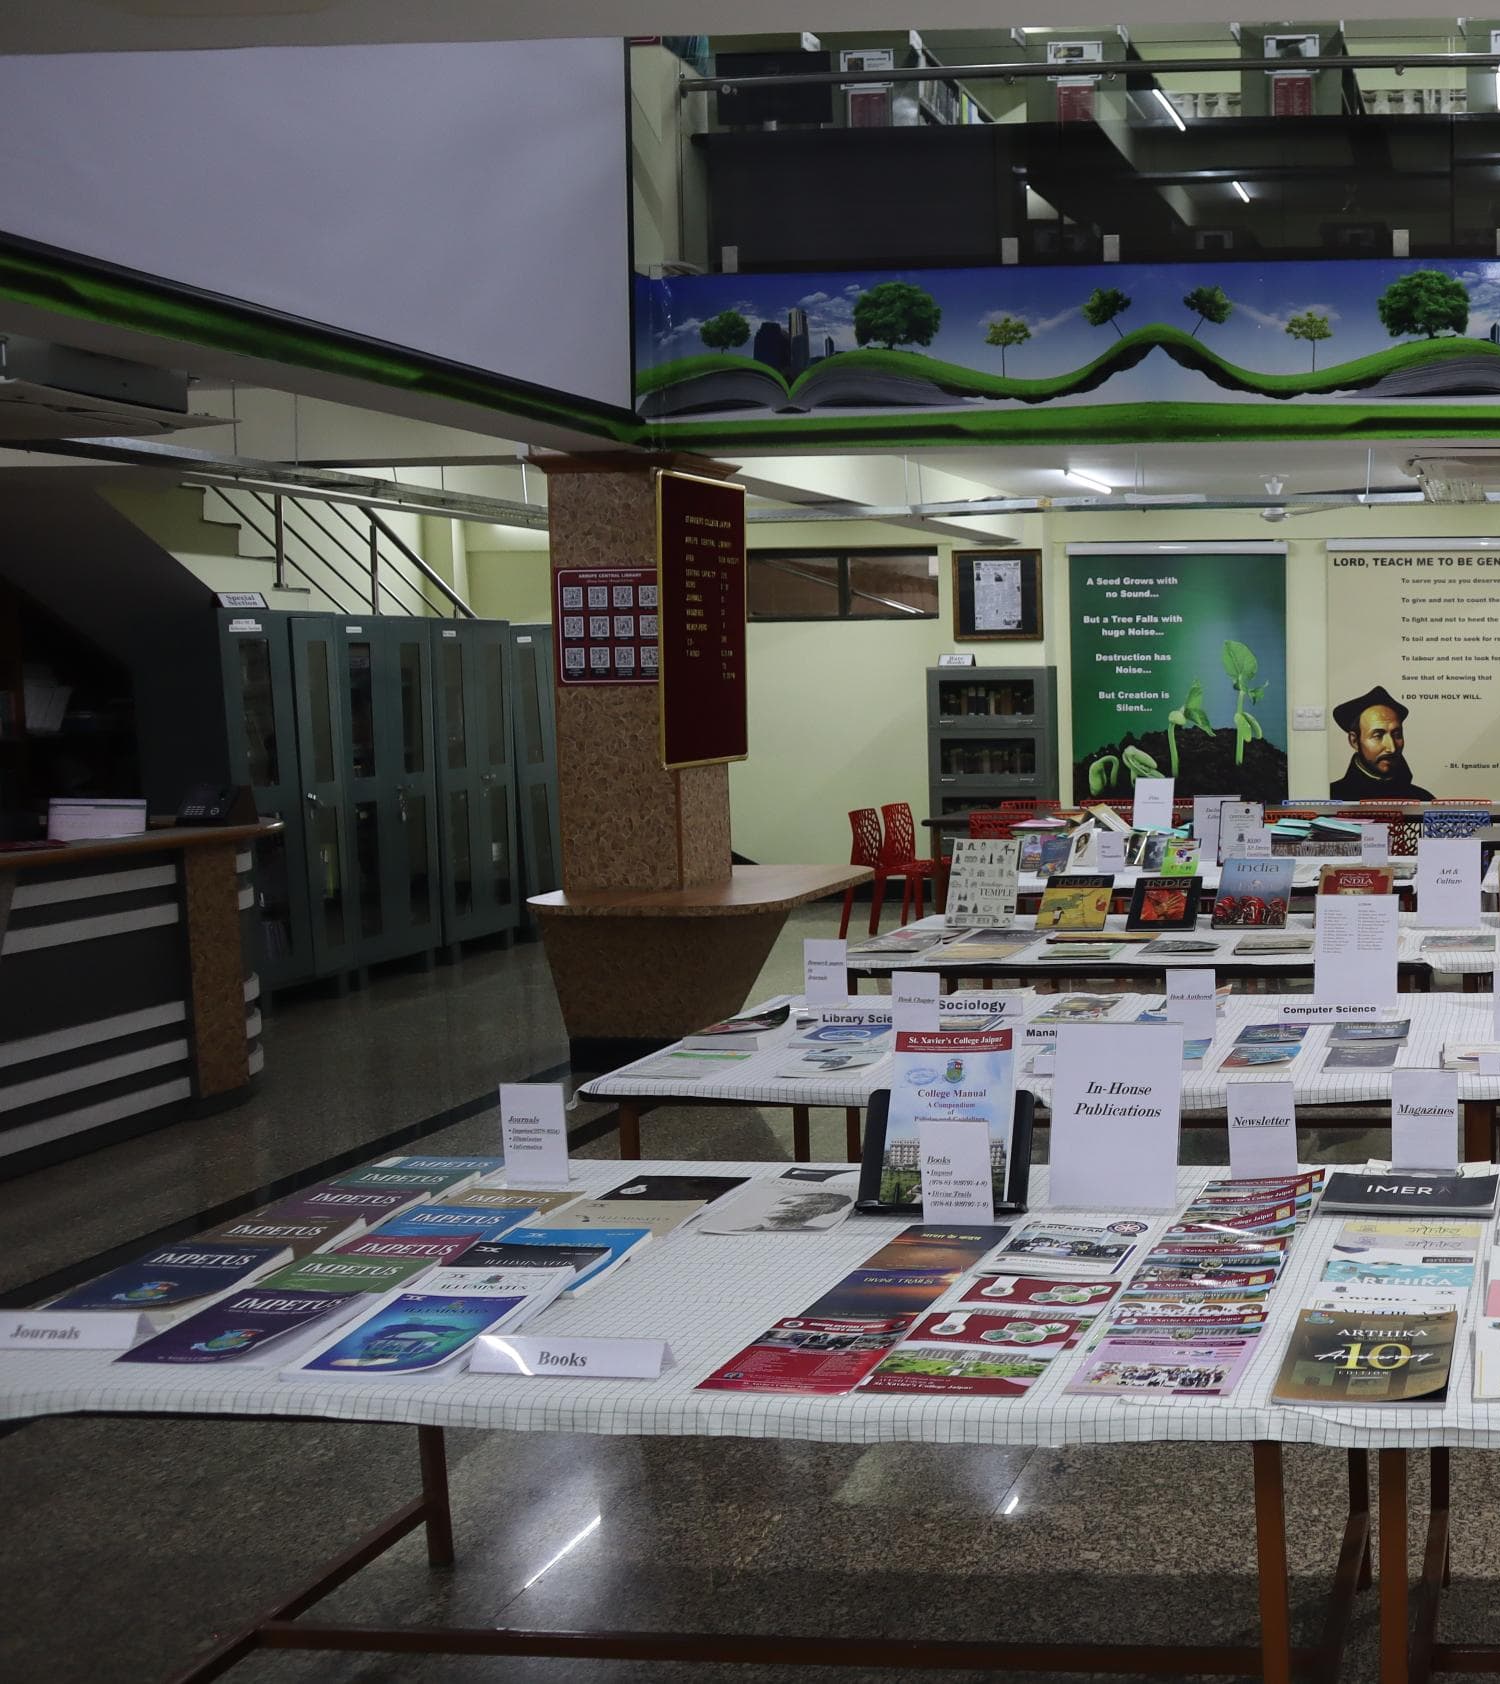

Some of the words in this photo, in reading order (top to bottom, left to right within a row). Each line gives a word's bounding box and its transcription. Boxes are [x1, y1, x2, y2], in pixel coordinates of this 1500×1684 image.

[1334, 558, 1369, 568] LORD,
[1373, 557, 1412, 566] TEACH
[1417, 557, 1434, 566] ME
[1438, 557, 1454, 566] TO
[1458, 557, 1473, 566] BE
[1123, 577, 1153, 585] Grows
[1121, 590, 1159, 598] Sound...
[1084, 615, 1099, 623] But
[1111, 615, 1132, 623] Tree
[1136, 615, 1158, 623] Falls
[1161, 615, 1182, 623] with
[1102, 628, 1125, 636] huge
[1238, 863, 1279, 872] india
[1145, 879, 1192, 888] INDIA
[940, 1001, 1005, 1012] Sociology
[1283, 1005, 1332, 1014] Computer
[1336, 1005, 1377, 1014] Science
[822, 1015, 863, 1024] Library
[954, 1037, 979, 1045] College
[918, 1089, 950, 1098] College
[954, 1089, 986, 1097] Manual
[1086, 1081, 1152, 1096] In-House
[1074, 1103, 1162, 1119] Publications
[1397, 1104, 1455, 1117] Magazines
[508, 1116, 539, 1124] Journals
[1233, 1116, 1290, 1127] Newsletter
[927, 1156, 951, 1165] Books
[360, 1173, 449, 1183] IMPETUS
[1367, 1185, 1432, 1195] IMER
[309, 1193, 401, 1203] IMPETUS
[464, 1195, 553, 1203] IMPETUS
[409, 1213, 505, 1224] IMPETUS
[227, 1225, 328, 1237] IMPETUS
[353, 1242, 459, 1255] IMPETUS
[150, 1253, 256, 1266] IMPETUS
[298, 1263, 403, 1276] IMPETUS
[1345, 1277, 1452, 1285] ARTHIKA
[9, 1324, 80, 1341] Journals
[1336, 1329, 1428, 1337] ARTHIKA
[537, 1351, 587, 1367] Books
[1335, 1343, 1412, 1369] 10
